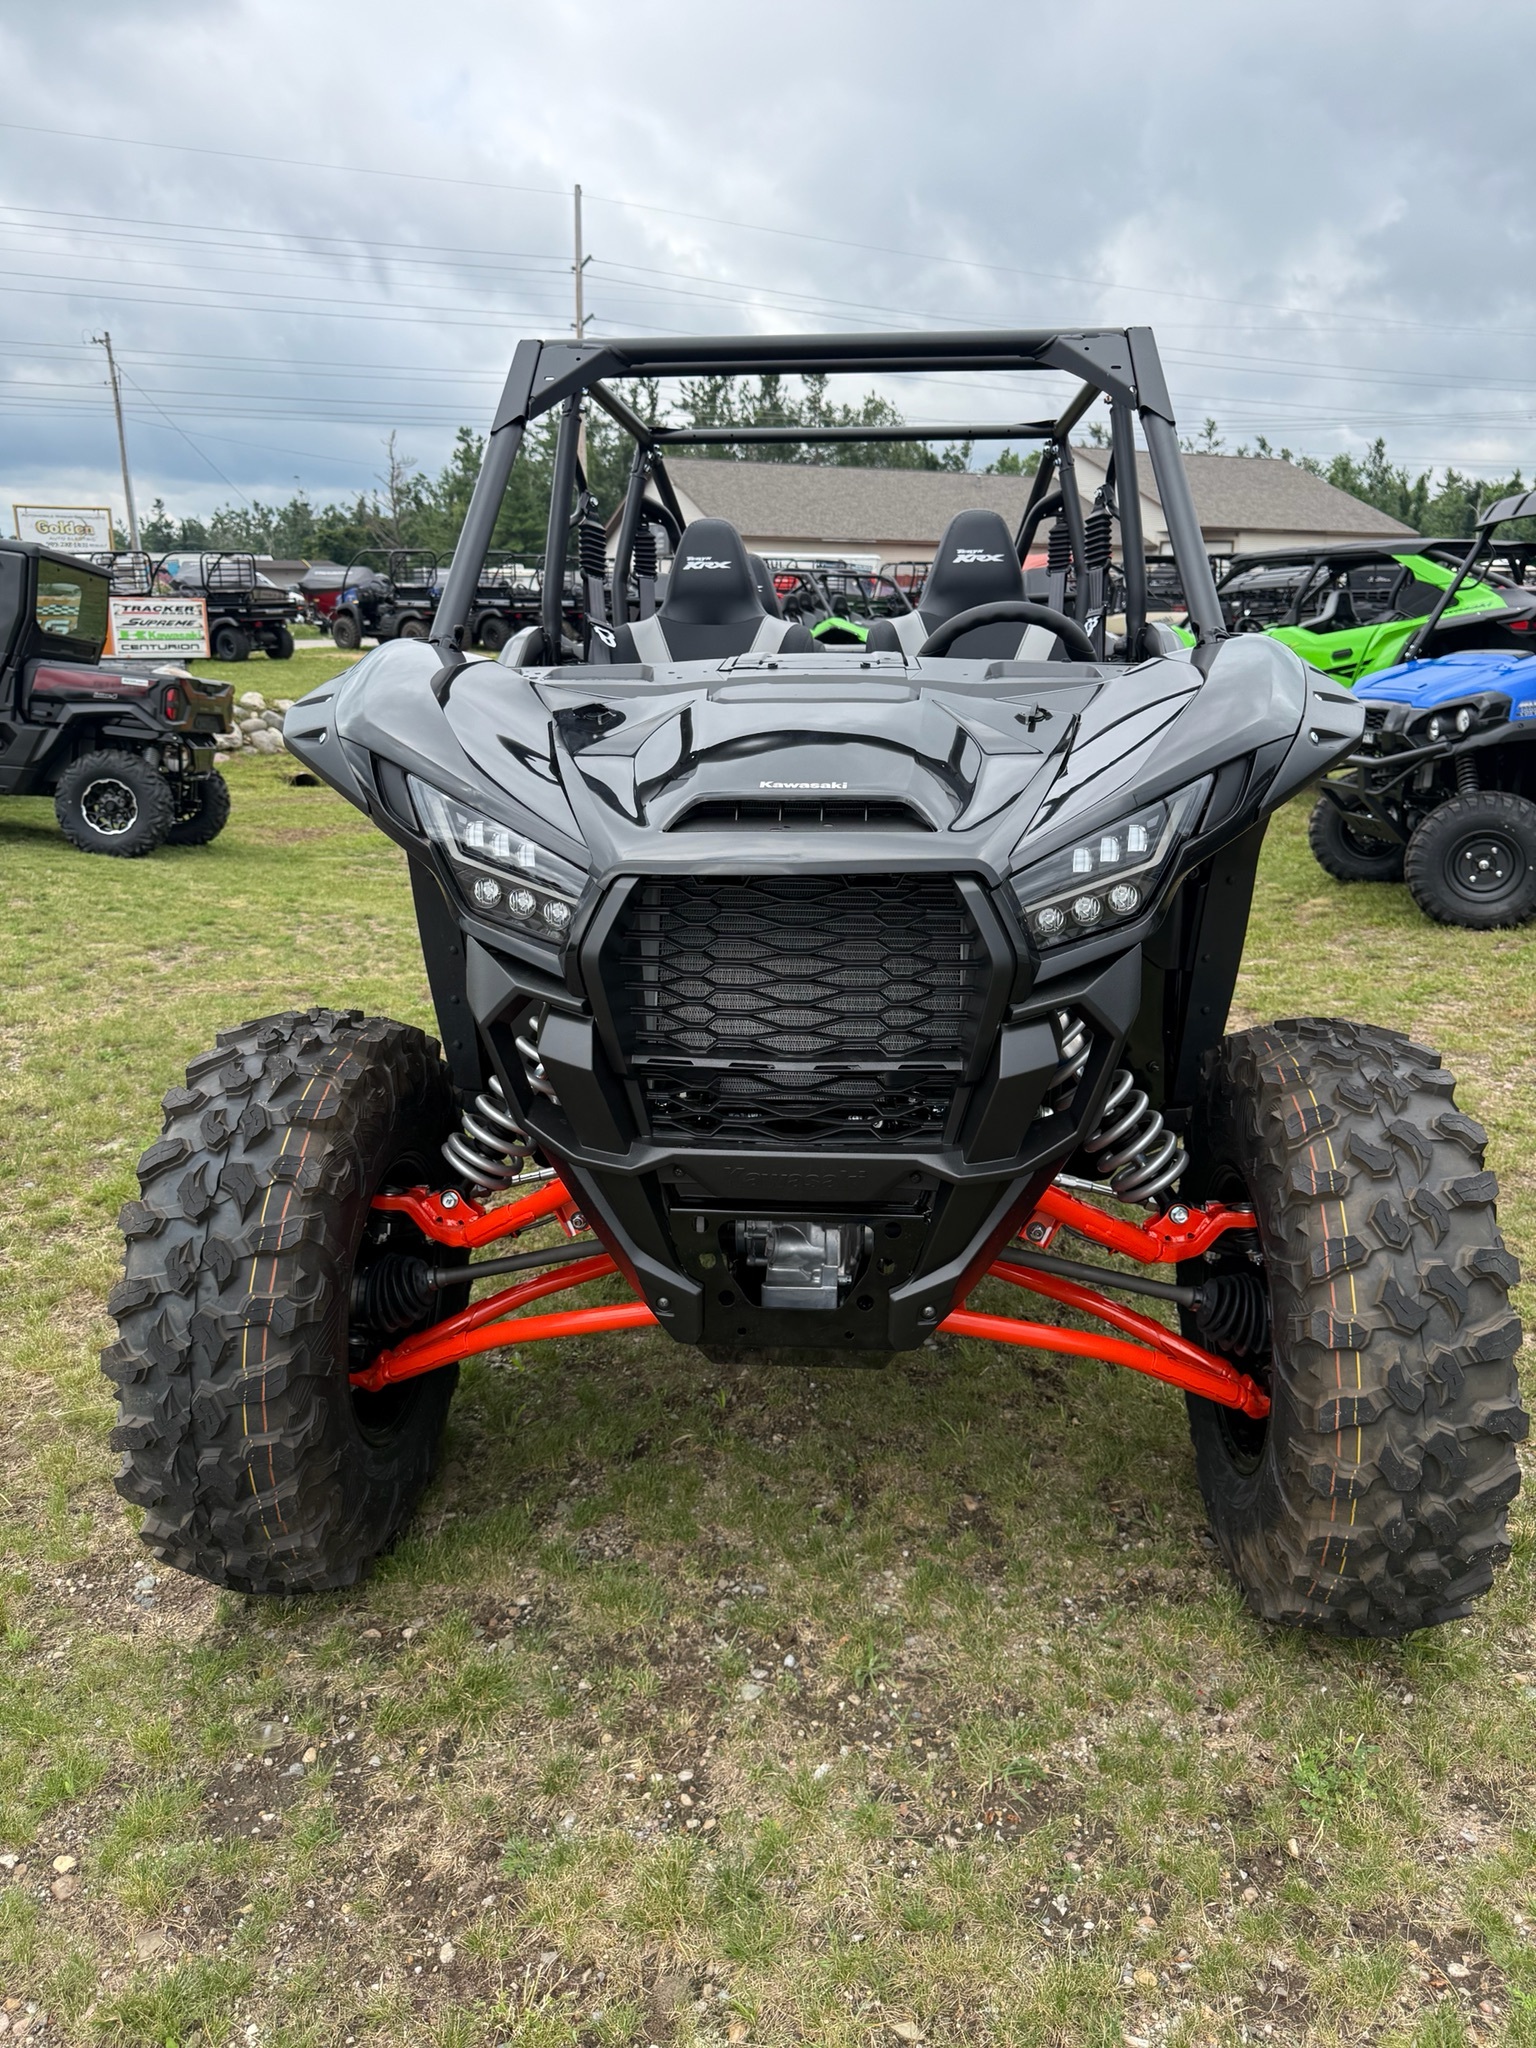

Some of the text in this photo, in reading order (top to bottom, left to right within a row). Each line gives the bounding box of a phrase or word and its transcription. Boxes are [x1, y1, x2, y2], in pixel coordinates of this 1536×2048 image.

[35, 520, 95, 536] Golden
[952, 554, 1005, 563] KRX
[682, 561, 732, 570] KRX
[122, 618, 197, 626] SUPREME
[148, 629, 201, 639] Kawasaki
[759, 780, 848, 789] Kawasaki
